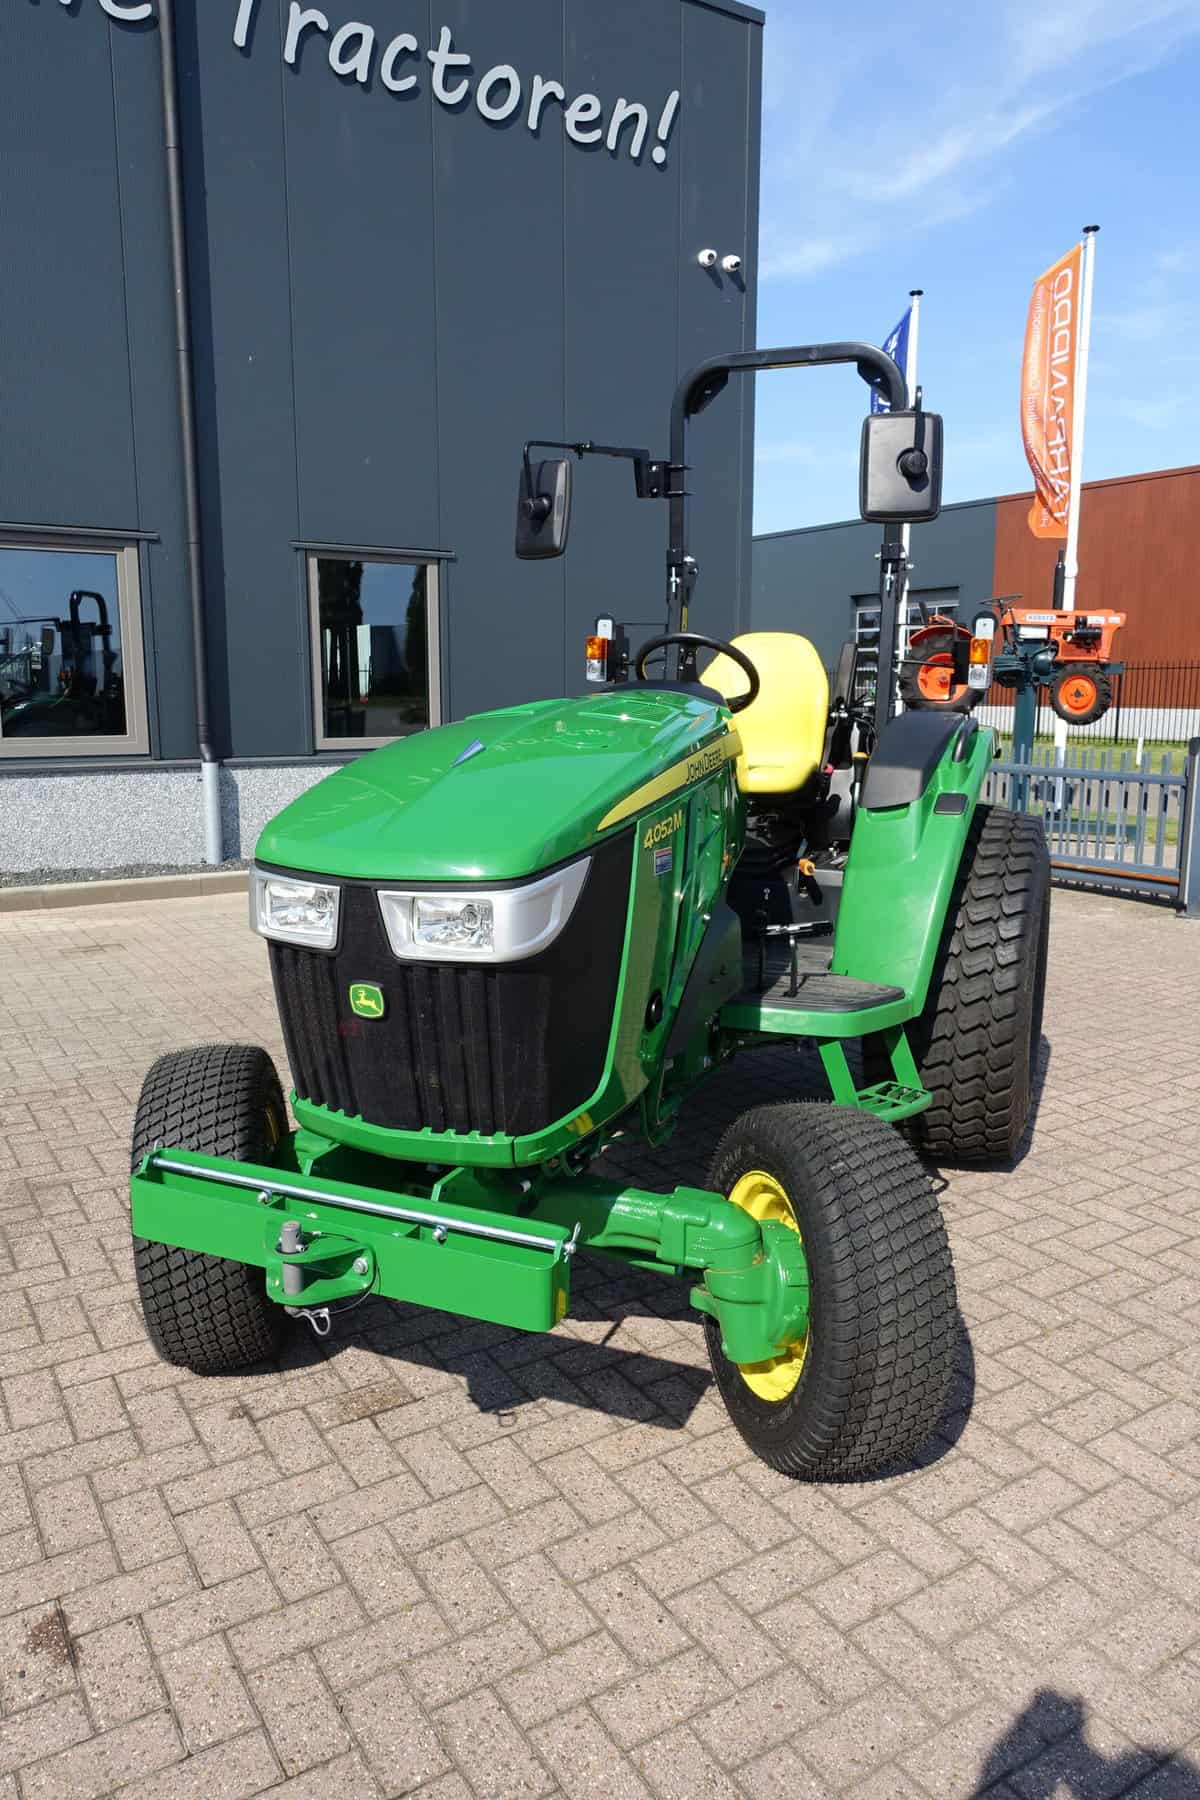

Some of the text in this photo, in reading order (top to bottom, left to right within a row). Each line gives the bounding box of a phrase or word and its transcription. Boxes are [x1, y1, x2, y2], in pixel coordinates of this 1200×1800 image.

[686, 748, 722, 783] JOHN DEERE
[644, 810, 682, 848] 4052M
